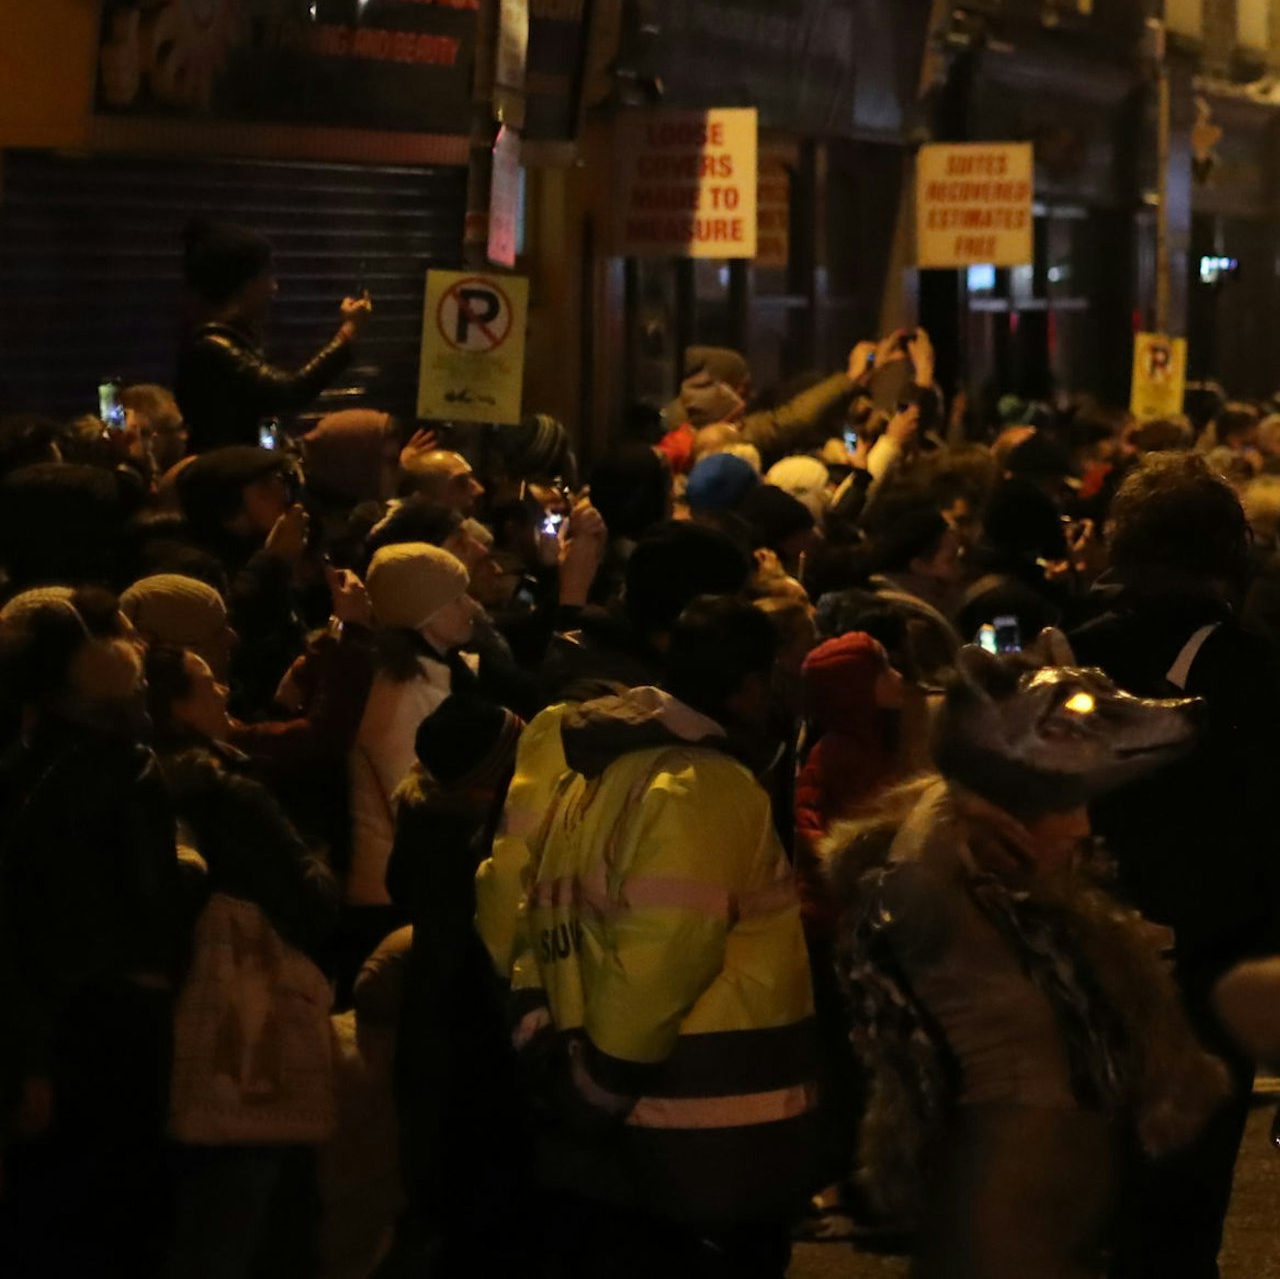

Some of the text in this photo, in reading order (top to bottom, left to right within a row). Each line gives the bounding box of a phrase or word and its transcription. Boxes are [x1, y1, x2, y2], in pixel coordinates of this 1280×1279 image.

[645, 122, 725, 147] LOOSE
[638, 154, 734, 179] COVERS
[630, 186, 740, 211] MADE TO
[625, 218, 744, 243] MEASURE
[927, 208, 1026, 230] ESTIMATES
[954, 235, 998, 258] FREE
